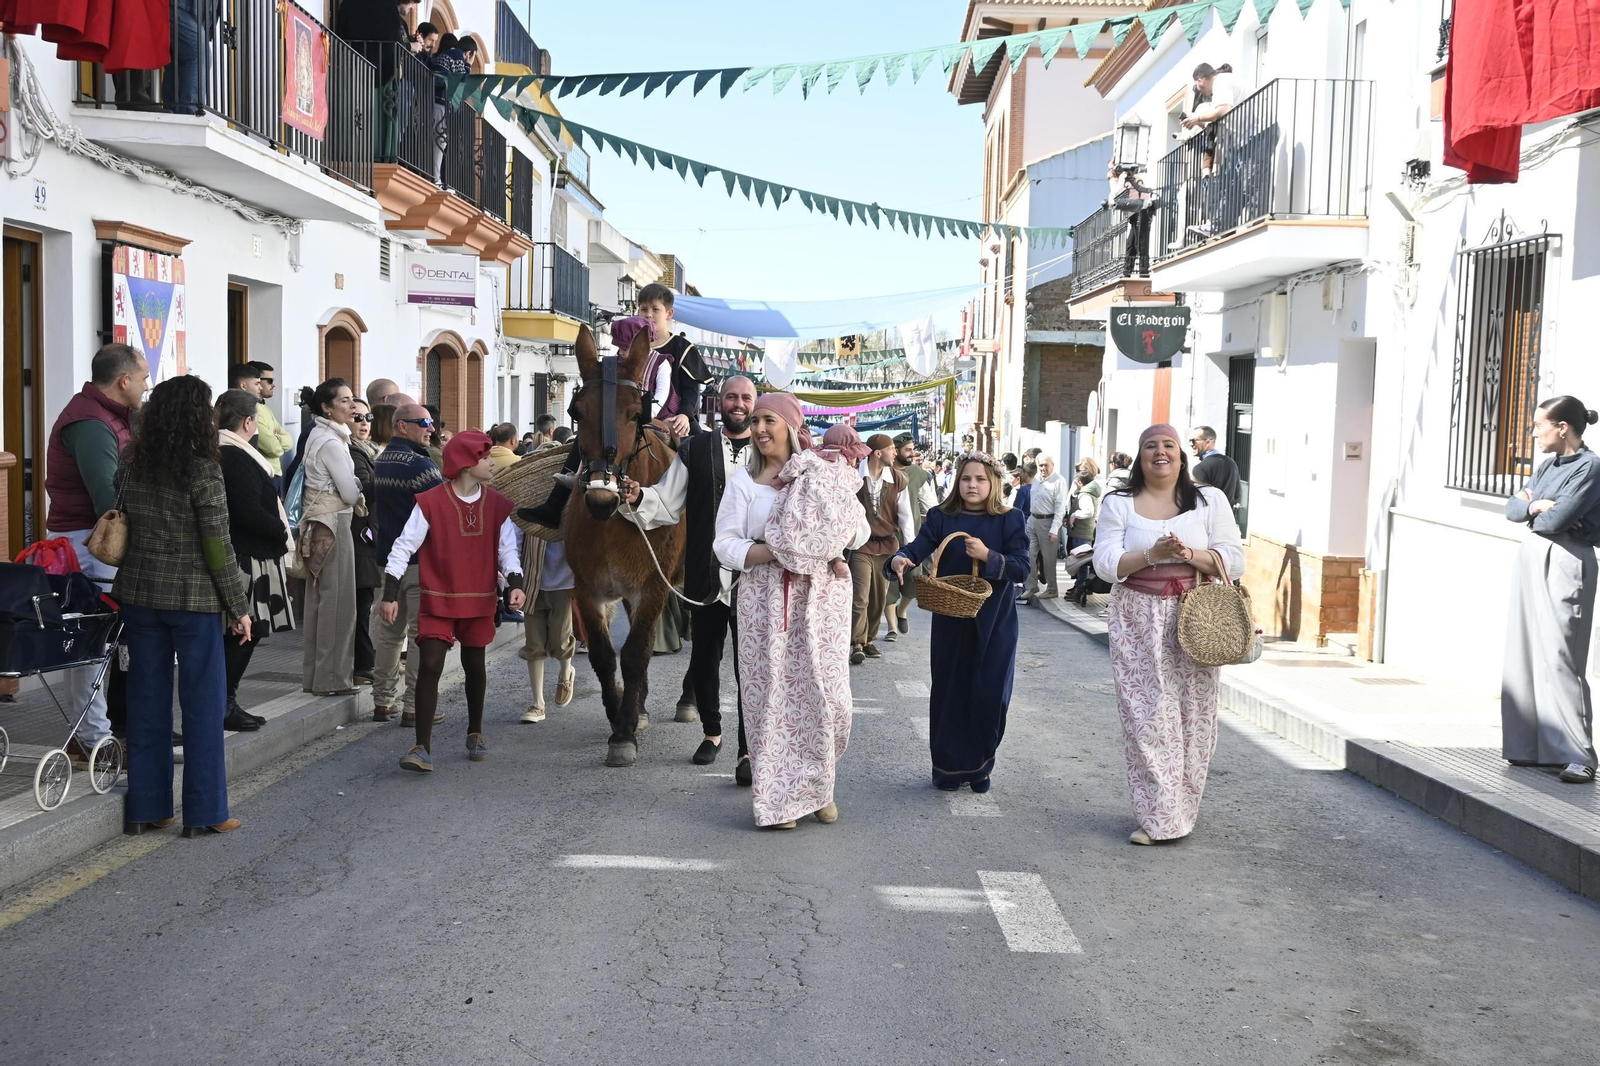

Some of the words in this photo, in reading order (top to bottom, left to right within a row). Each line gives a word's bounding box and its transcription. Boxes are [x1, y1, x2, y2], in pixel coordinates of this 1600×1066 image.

[34, 185, 47, 204] 49
[427, 269, 474, 280] DENTAL
[1116, 313, 1132, 326] El
[1134, 314, 1185, 328] Bodegón
